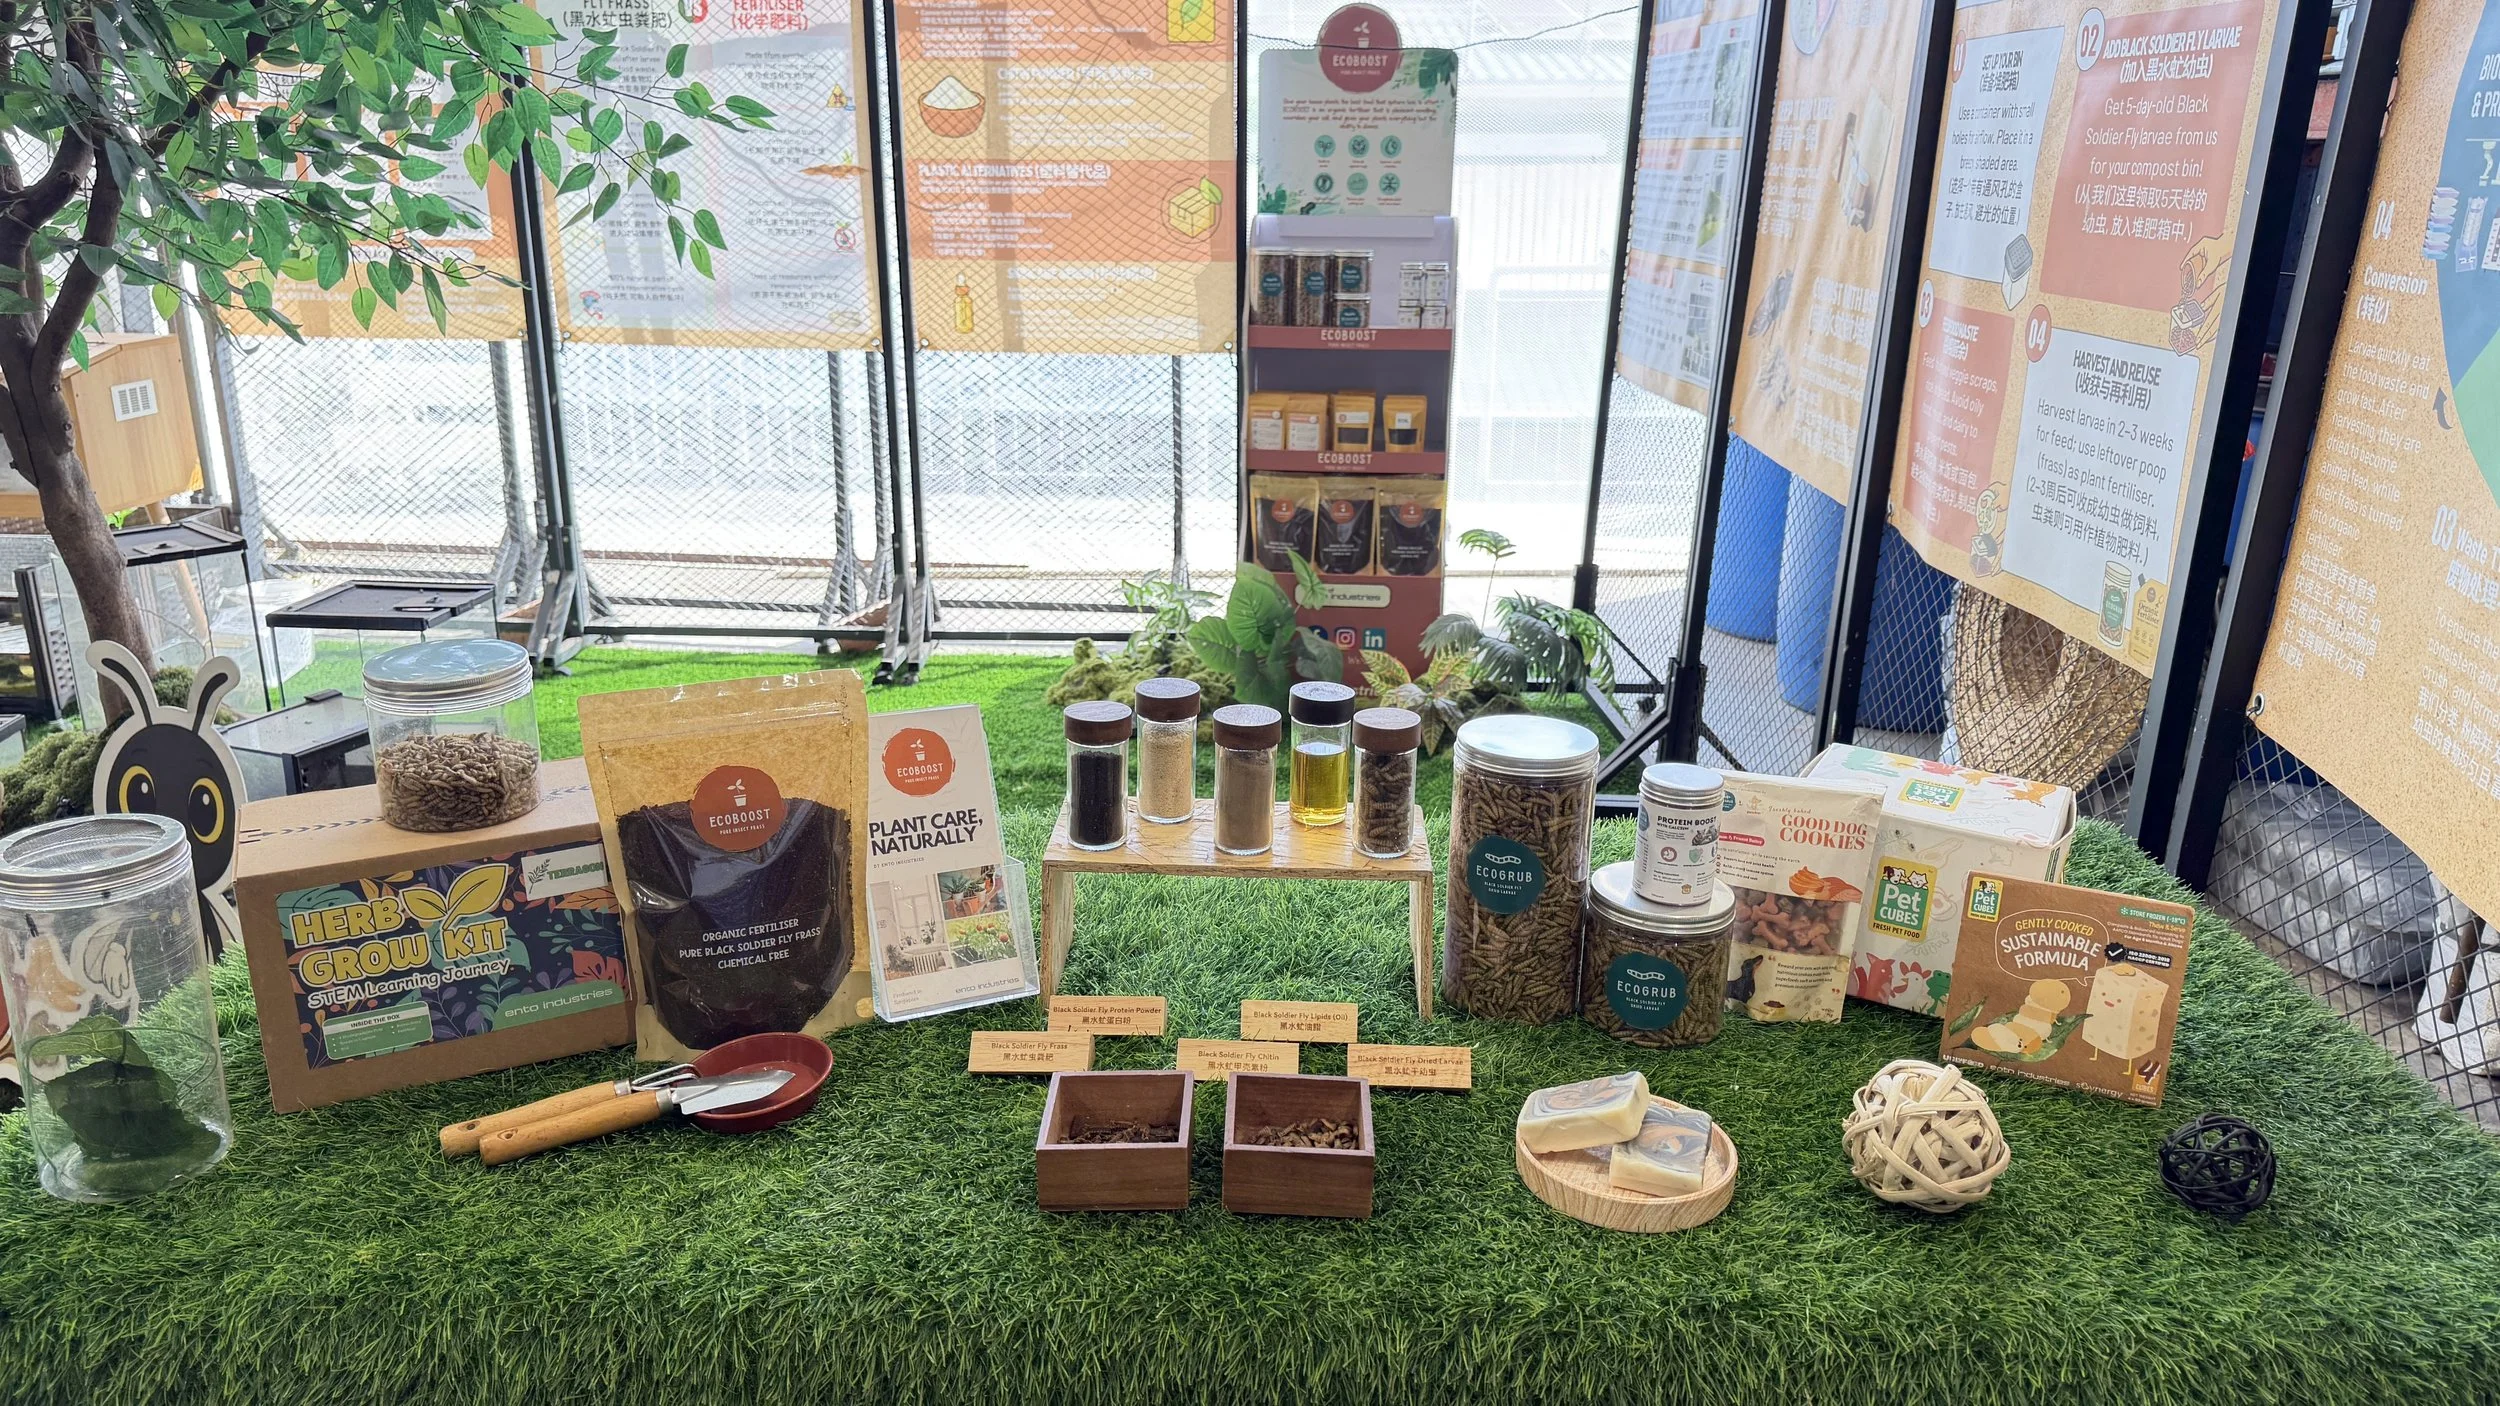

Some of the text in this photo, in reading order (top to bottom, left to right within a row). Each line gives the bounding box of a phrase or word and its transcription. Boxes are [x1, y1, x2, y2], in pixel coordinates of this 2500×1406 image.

[732, 13, 808, 30] (化学肥料)
[2081, 24, 2100, 58] 02
[2103, 26, 2243, 59] ADD BLACK SOLDIER FLY LARVAE
[1332, 54, 1389, 67] ECOBOOST
[2120, 53, 2213, 84] (加入黑水虻幼虫)
[2104, 94, 2208, 118] Get 5-day-old Black
[2085, 126, 2218, 149] Soldier Fly larvae from us
[2090, 156, 2204, 180] for your compost bin!
[2075, 184, 2208, 212] (从我们这里领取5天龄的
[2373, 200, 2395, 240] 04
[2364, 264, 2428, 295] Conversion
[2356, 294, 2390, 324] (转化)
[1321, 329, 1377, 341] ECOBOOST
[2028, 318, 2048, 351] 04
[2073, 349, 2162, 387] HARVEST AND REUSE
[2377, 342, 2431, 371] quickly eat
[2075, 371, 2151, 411] (收获与再利用)
[2358, 365, 2407, 393] food waste
[1969, 398, 1984, 417] oily
[2037, 398, 2075, 423] Harvest
[2077, 409, 2104, 432] larvae
[2106, 417, 2116, 435] in
[2139, 431, 2174, 452] weeks
[1317, 453, 1373, 464] ECOBOOST
[2036, 425, 2167, 484] for feed; use leftover poop
[2037, 451, 2155, 508] (frass) as plant fertiliser.
[2431, 504, 2458, 552] 03
[2456, 527, 2488, 565] Waste
[1330, 593, 1381, 601] industries
[2447, 619, 2481, 648] ensure
[2428, 637, 2477, 681] consistent
[897, 763, 943, 778] ECOBOOST
[709, 808, 771, 828] ECOBOOST
[1657, 816, 1717, 826] PROTEIN BOOST
[1768, 806, 1791, 815] Freshly
[869, 808, 983, 838] PLANT CARE,
[1781, 814, 1868, 836] GOOD DOG
[871, 826, 976, 856] NATURALLY
[1779, 826, 1866, 850] COOKIES
[1476, 864, 1533, 883] ECOGRUB
[1882, 883, 1921, 912] Pet
[1973, 903, 1995, 914] CUBES
[1975, 891, 1996, 907] Pet
[290, 898, 405, 948] HERB
[1880, 906, 1919, 926] CUBES
[2129, 909, 2166, 921] STORE FROZEN
[702, 918, 799, 942] ORGANIC FERTILISER
[1873, 922, 1920, 939] FRESH PET FOOD
[2015, 918, 2054, 931] GENTLY
[2054, 919, 2094, 937] COOKED
[300, 917, 508, 987] GROW KIT
[679, 926, 821, 959] PURE BLACK SOLDIER FLY FRASS
[2000, 932, 2102, 957] SUSTAINABLE
[718, 949, 790, 970] CHEMICAL FREE
[2014, 951, 2089, 971] FORMULA
[307, 958, 511, 1009] STEM Learning Journey
[955, 977, 1020, 994] ento industries
[1617, 980, 1677, 999] ECOGRUB
[505, 986, 614, 1018] ento industries
[1053, 1006, 1162, 1015] Black Soldier Fly Protein Powder
[351, 1013, 400, 1029] INSIDE THE BOX
[1082, 1015, 1131, 1025] 黑水虻蛋白粉
[1253, 1011, 1348, 1022] Black Soldier Fly Lipids (Oil)
[1012, 1042, 1036, 1050] Soldier
[1038, 1042, 1048, 1051] Fly
[1050, 1042, 1068, 1050] Frass
[1219, 1051, 1243, 1059] Soldier
[1245, 1052, 1256, 1060] Fly
[1405, 1056, 1415, 1065] Fly
[1438, 1058, 1464, 1066] Larvae
[2017, 1070, 2071, 1087] industries
